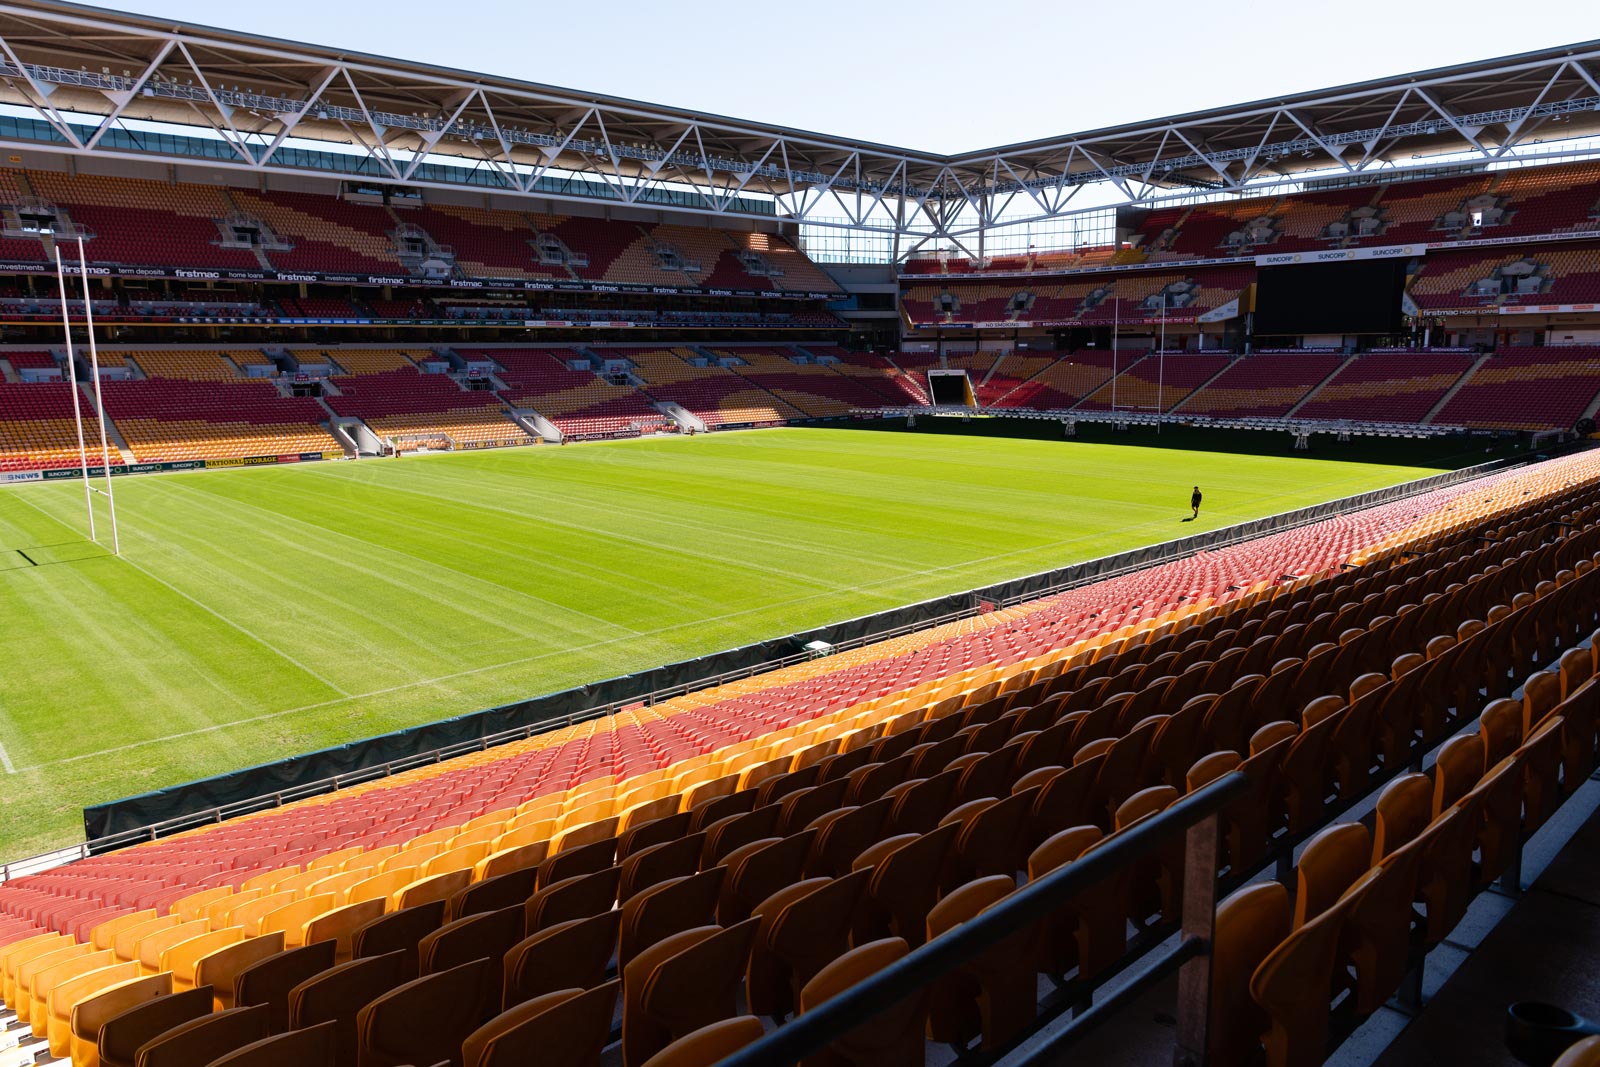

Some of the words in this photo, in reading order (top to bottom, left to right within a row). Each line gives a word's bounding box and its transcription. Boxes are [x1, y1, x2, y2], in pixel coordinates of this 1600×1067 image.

[0, 264, 45, 272] nvestments
[60, 265, 110, 275] firsmac
[118, 267, 134, 275] term
[136, 268, 165, 277] deposits
[175, 269, 220, 279] firstmac
[277, 273, 317, 281] firstmac
[368, 276, 404, 284] firstmac
[450, 279, 483, 287] firstmac
[591, 284, 618, 292] firstmac
[206, 458, 244, 467] NATIONAL
[244, 456, 277, 465] STORAGE
